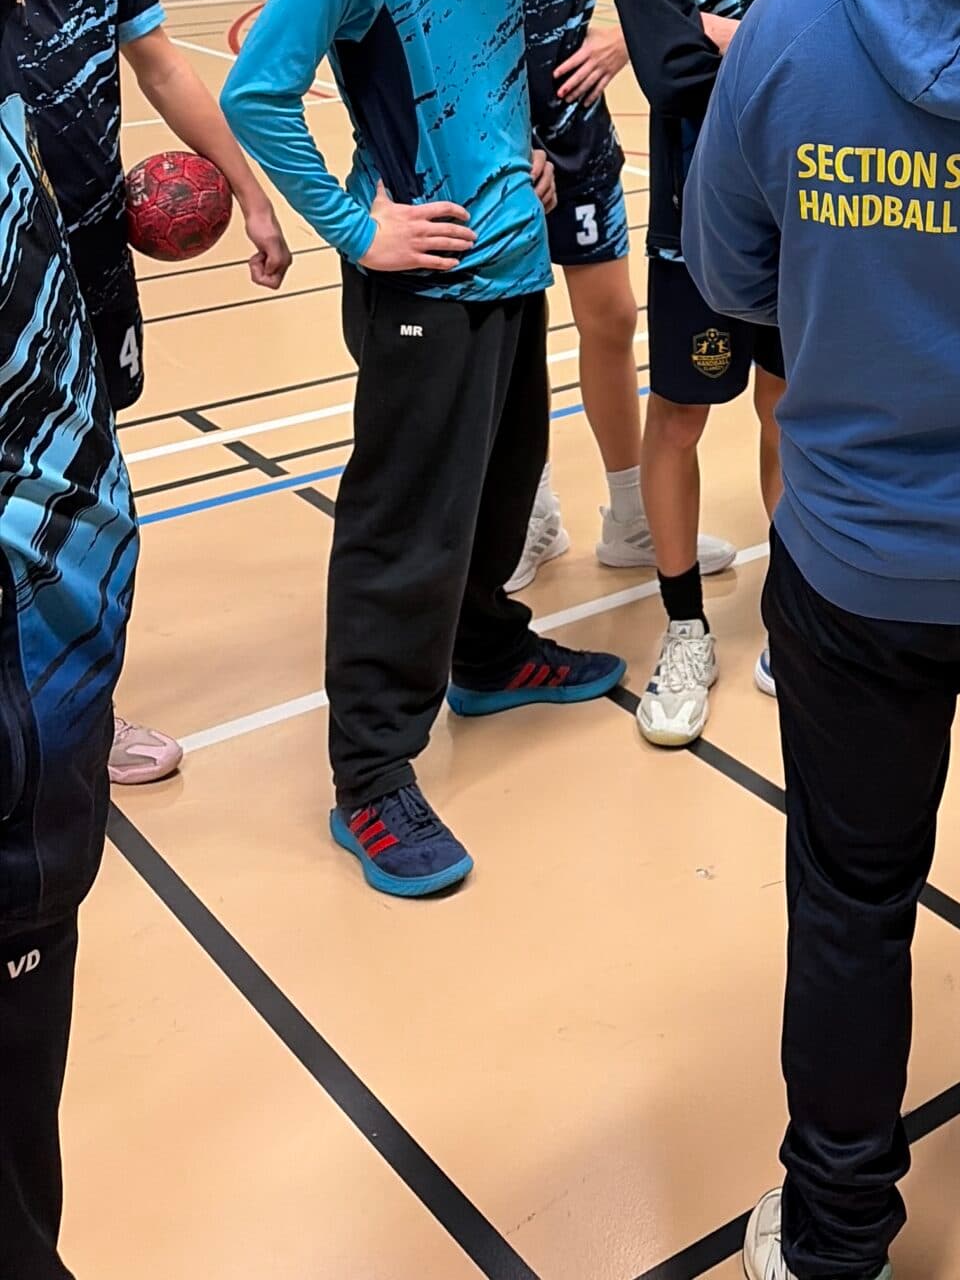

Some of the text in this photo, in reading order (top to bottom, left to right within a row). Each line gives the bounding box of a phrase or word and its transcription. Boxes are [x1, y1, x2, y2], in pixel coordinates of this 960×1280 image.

[796, 143, 937, 189] SECTION
[575, 203, 599, 246] 3
[798, 189, 957, 234] HANDBALL
[119, 325, 140, 378] 4
[400, 324, 423, 336] MR
[7, 949, 40, 978] VD
